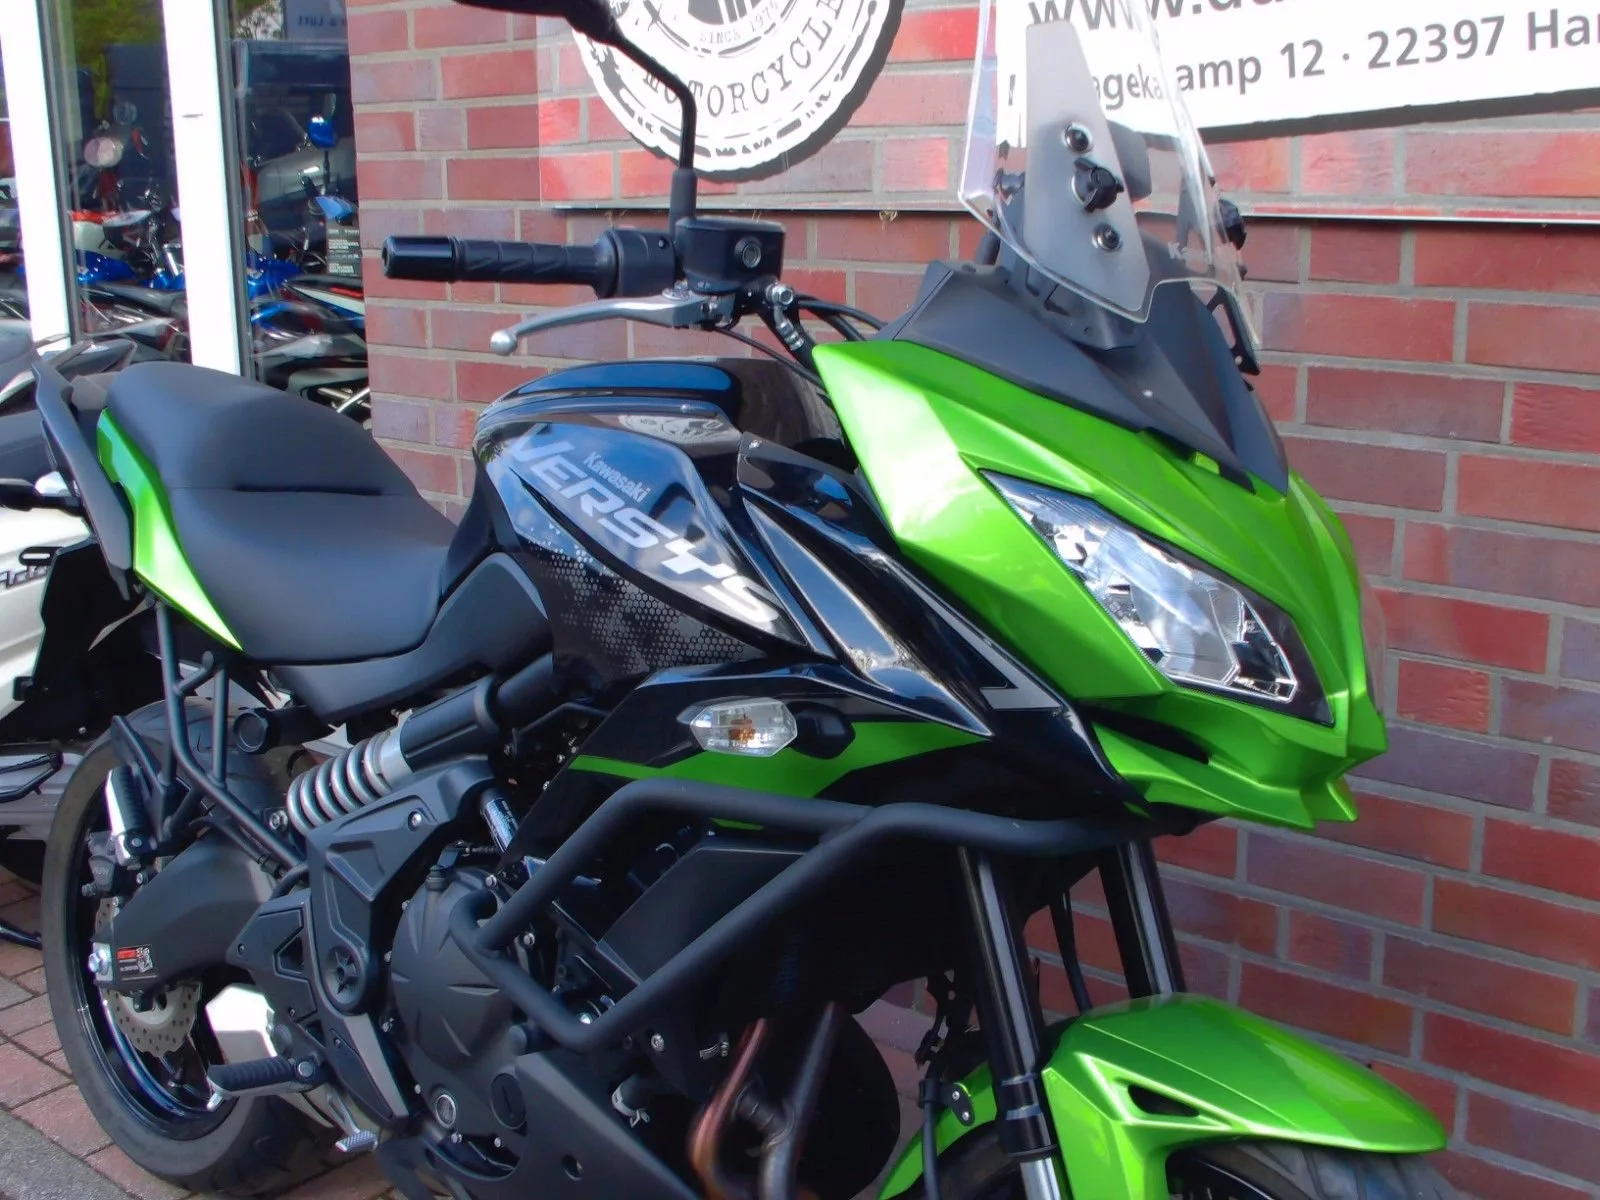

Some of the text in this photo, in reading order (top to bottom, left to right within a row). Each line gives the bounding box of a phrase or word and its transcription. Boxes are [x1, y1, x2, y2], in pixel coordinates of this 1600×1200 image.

[1280, 38, 1325, 78] 12
[1367, 15, 1505, 69] 22397
[1527, 8, 1600, 51] Ha
[583, 451, 652, 503] Kawasaki
[510, 422, 780, 623] VERSYS
